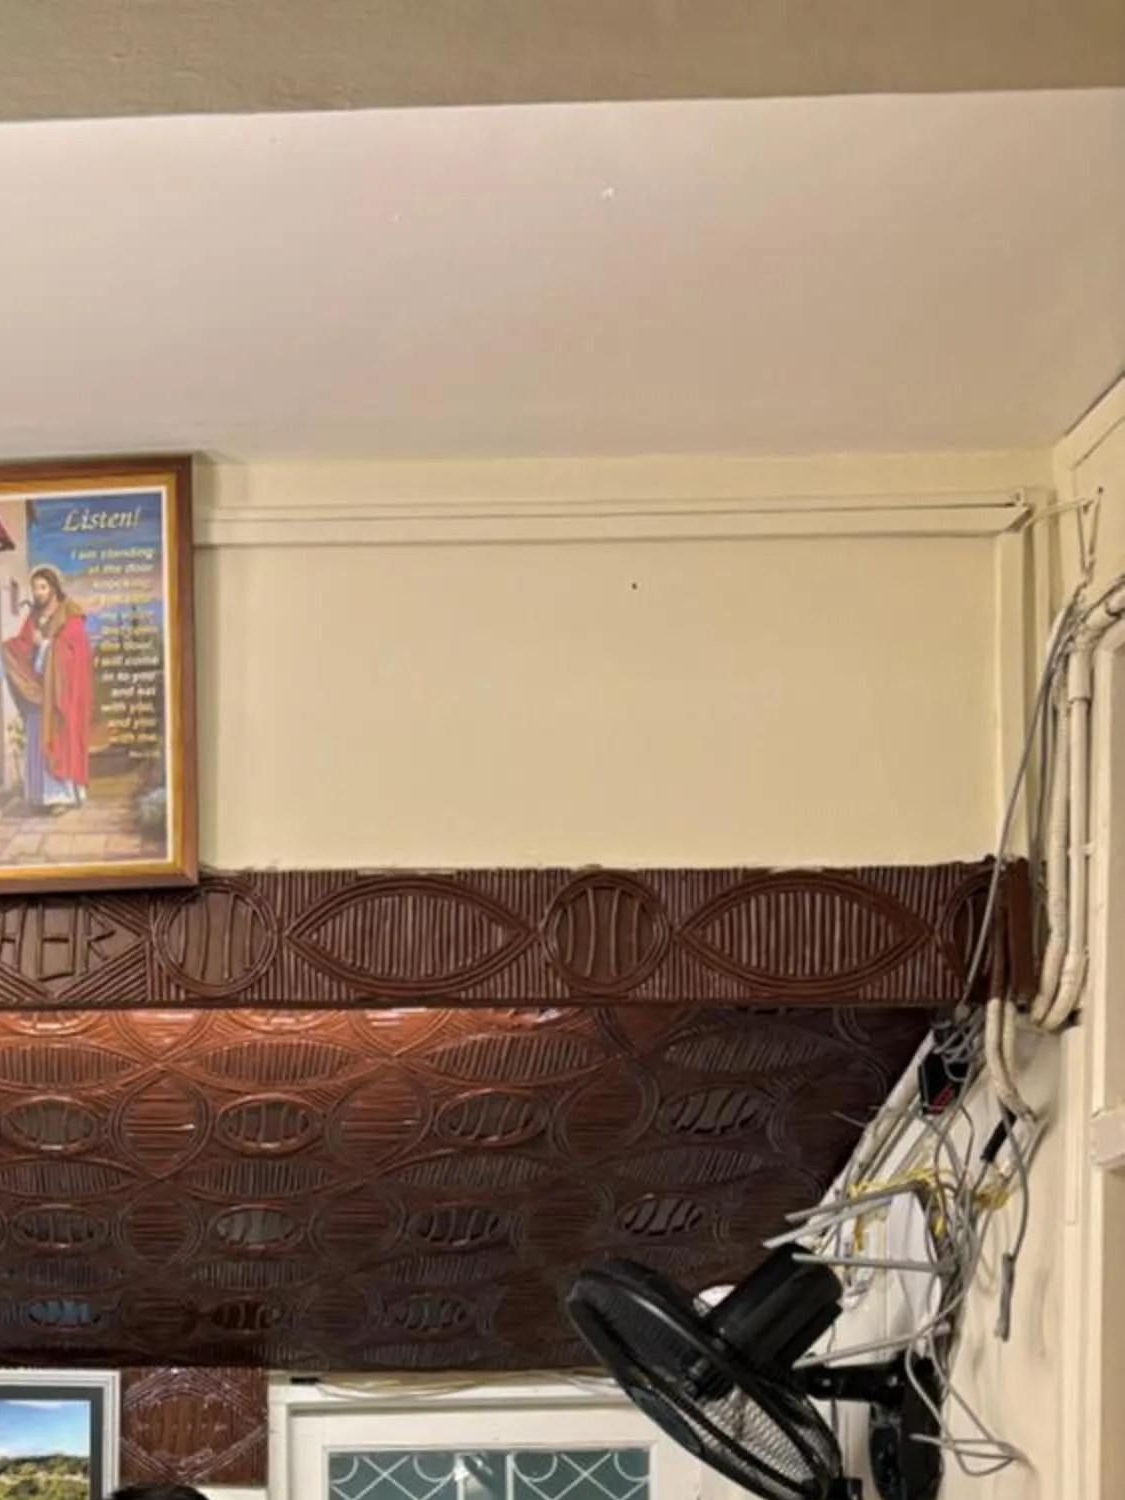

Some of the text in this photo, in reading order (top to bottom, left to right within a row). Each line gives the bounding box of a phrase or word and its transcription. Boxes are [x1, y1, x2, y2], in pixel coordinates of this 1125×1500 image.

[62, 506, 142, 532] Listen!
[100, 547, 155, 561] standing
[117, 671, 130, 681] to
[110, 686, 134, 698] and
[101, 701, 126, 713] with
